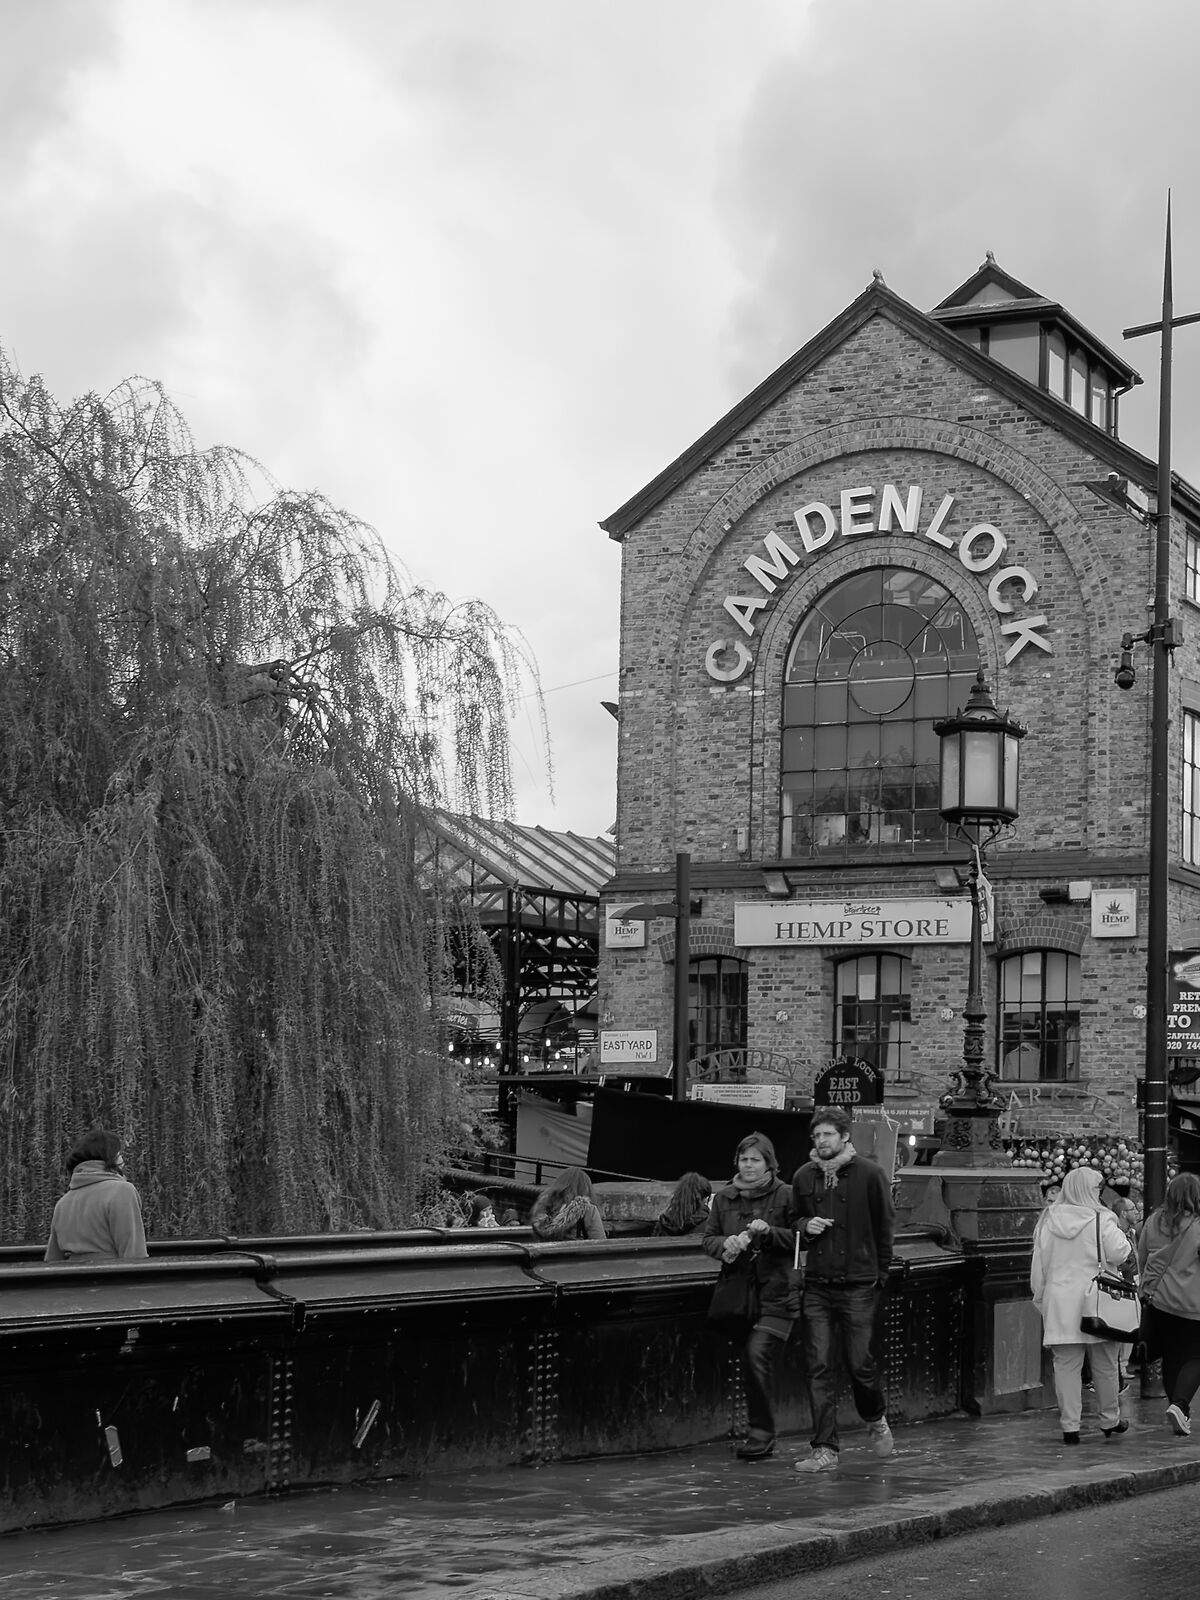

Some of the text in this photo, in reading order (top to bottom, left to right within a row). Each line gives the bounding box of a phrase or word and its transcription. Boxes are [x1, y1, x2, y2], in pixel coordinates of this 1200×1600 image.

[705, 484, 1053, 683] CAMDEN LOCK
[775, 919, 950, 940] HEMP STORE
[1167, 1014, 1192, 1028] TO
[603, 1040, 653, 1050] EAST YARD
[853, 1057, 877, 1083] LOCK
[829, 1077, 859, 1090] EAST
[827, 1090, 861, 1103] YARD
